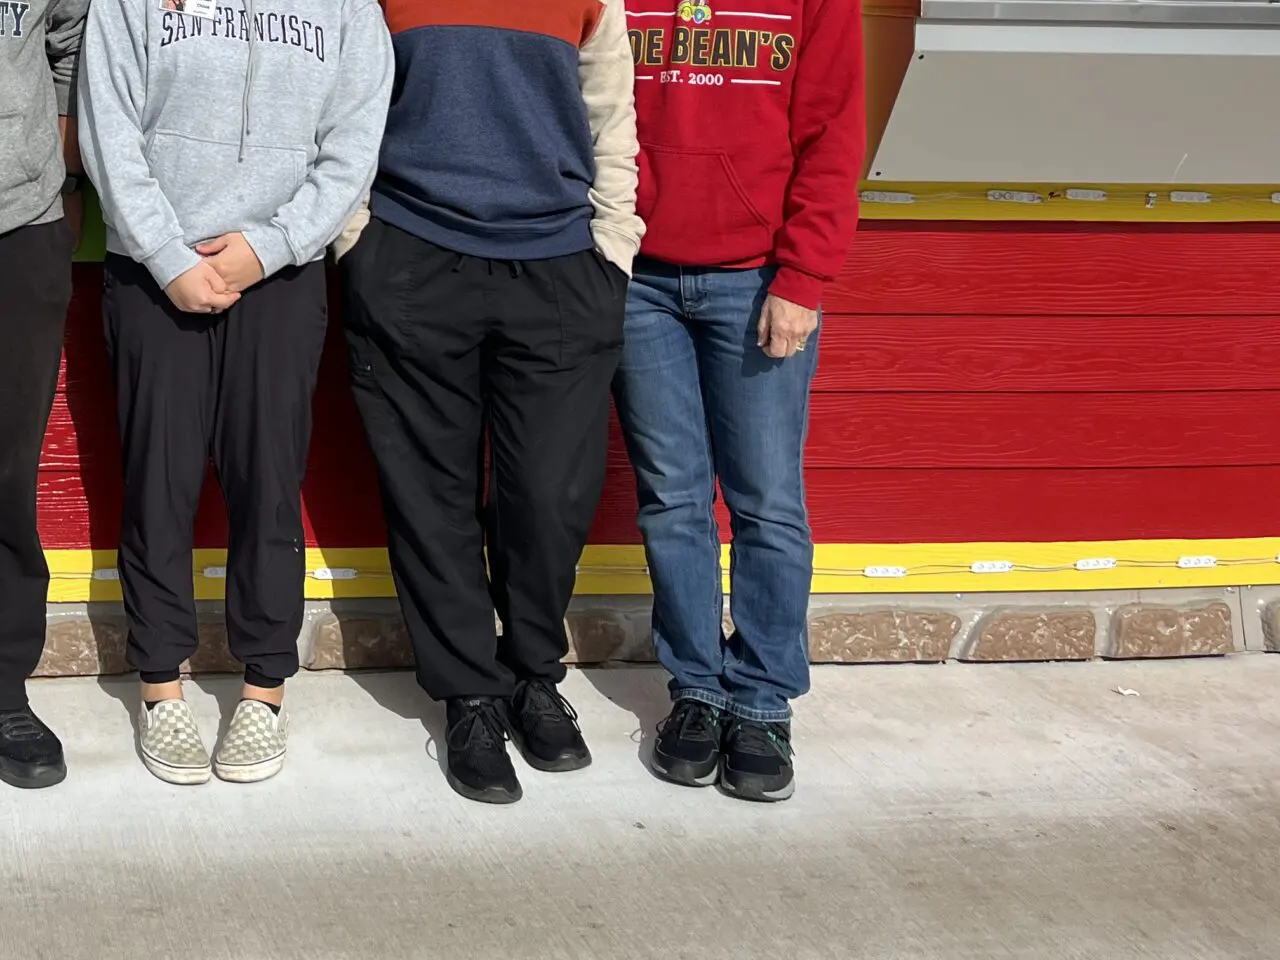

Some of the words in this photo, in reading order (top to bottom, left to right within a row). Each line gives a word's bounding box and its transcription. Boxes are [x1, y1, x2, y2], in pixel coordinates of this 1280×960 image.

[161, 11, 203, 47] SAN
[628, 28, 664, 66] OE
[671, 26, 795, 71] BEAN'S
[660, 70, 684, 84] EST.
[687, 73, 723, 86] 2000
